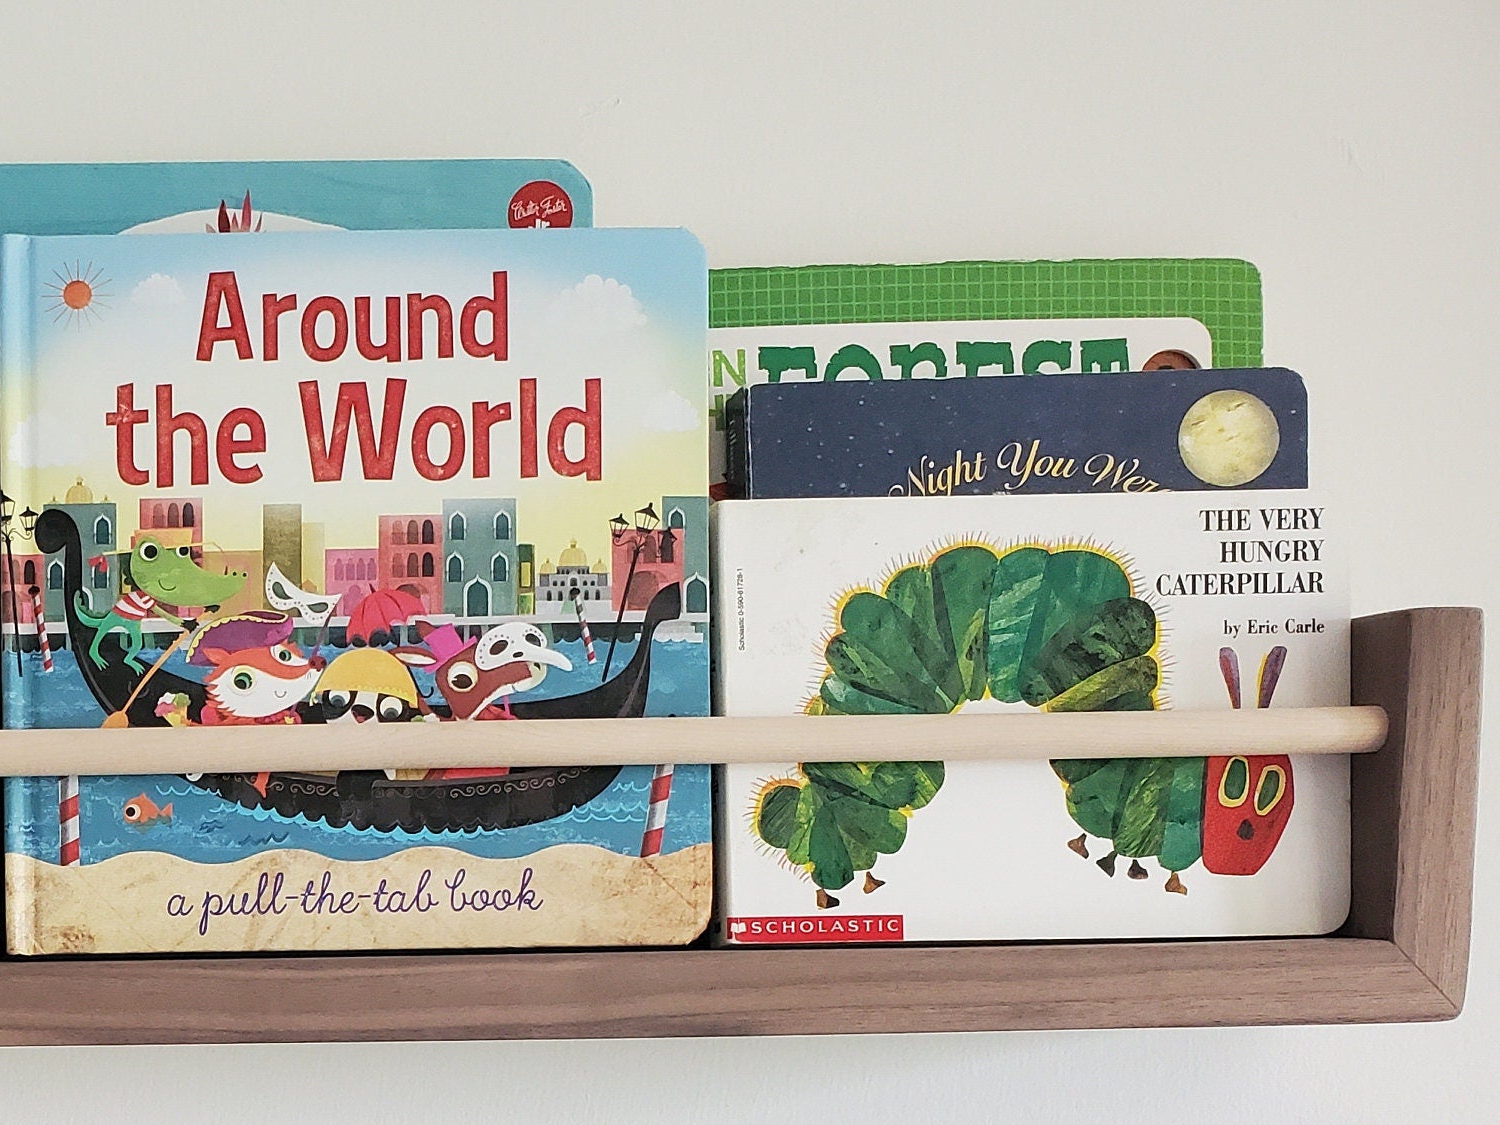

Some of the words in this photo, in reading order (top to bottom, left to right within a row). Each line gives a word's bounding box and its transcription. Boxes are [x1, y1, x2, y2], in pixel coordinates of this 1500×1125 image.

[195, 270, 508, 363] Around
[106, 381, 268, 488] the
[298, 377, 602, 483] World
[888, 450, 988, 496] Night
[996, 439, 1080, 490] You
[1084, 453, 1173, 493] Wer
[1199, 509, 1252, 532] THE
[1258, 507, 1325, 531] VERY
[1219, 539, 1325, 563] HUNGRY
[1155, 571, 1325, 596] CATERPILLAR
[1223, 619, 1241, 639] by
[1247, 619, 1278, 634] Eric
[1285, 618, 1325, 634] Carle
[166, 889, 196, 917] a
[200, 869, 439, 936] pull-the-tab
[444, 867, 544, 914] book
[751, 919, 900, 935] SCHOLASTIC
